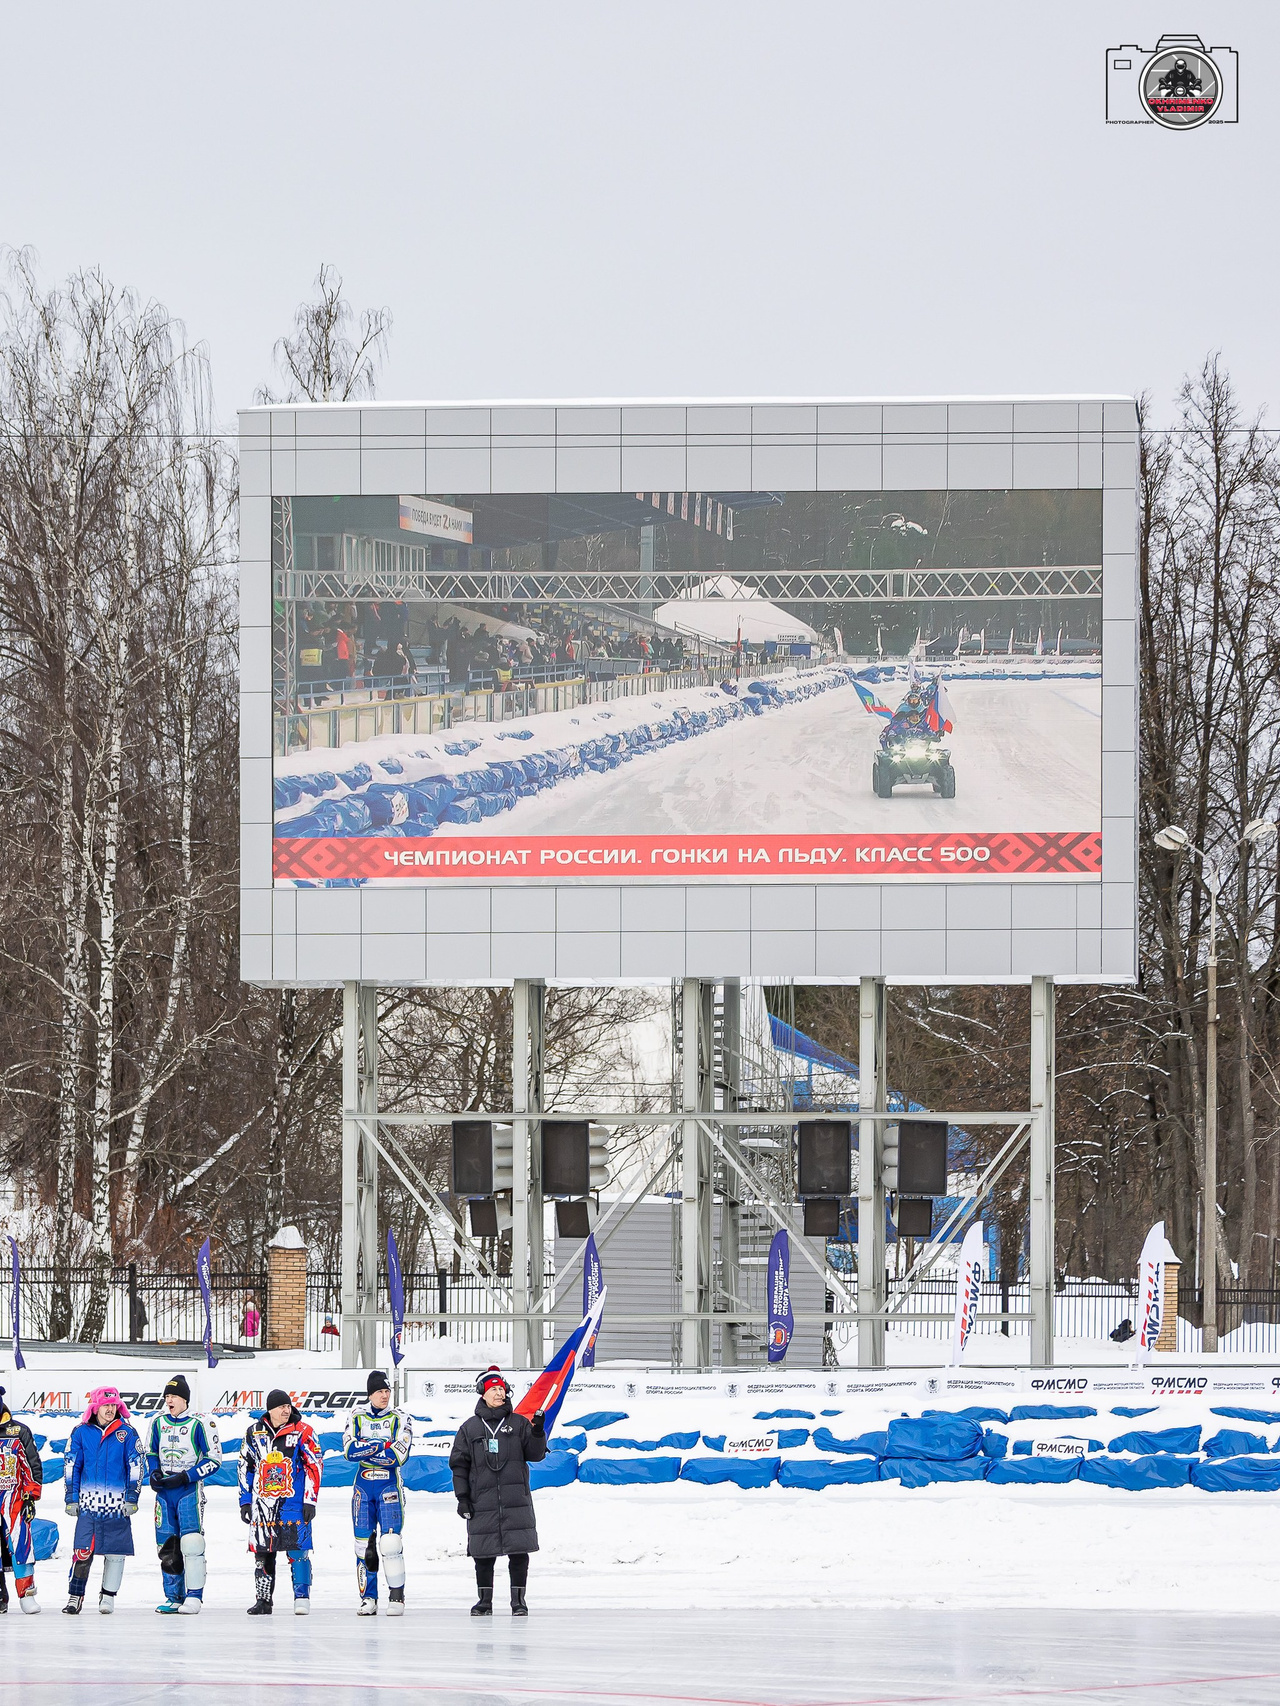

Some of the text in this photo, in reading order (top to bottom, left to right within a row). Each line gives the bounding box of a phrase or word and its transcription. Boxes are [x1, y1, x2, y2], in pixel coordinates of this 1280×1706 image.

[384, 846, 990, 866] ЧЕМПИОНАТ РОССИИ. ГОНКИ НА ЛЬДУ. КЛАСС 500
[1031, 1379, 1088, 1390] ФМСМО
[1151, 1377, 1208, 1388] ФМСМО
[302, 1391, 370, 1408] RGP
[285, 1434, 299, 1447] 84
[1037, 1443, 1084, 1453] ФМСМО
[196, 1461, 218, 1477] UFA
